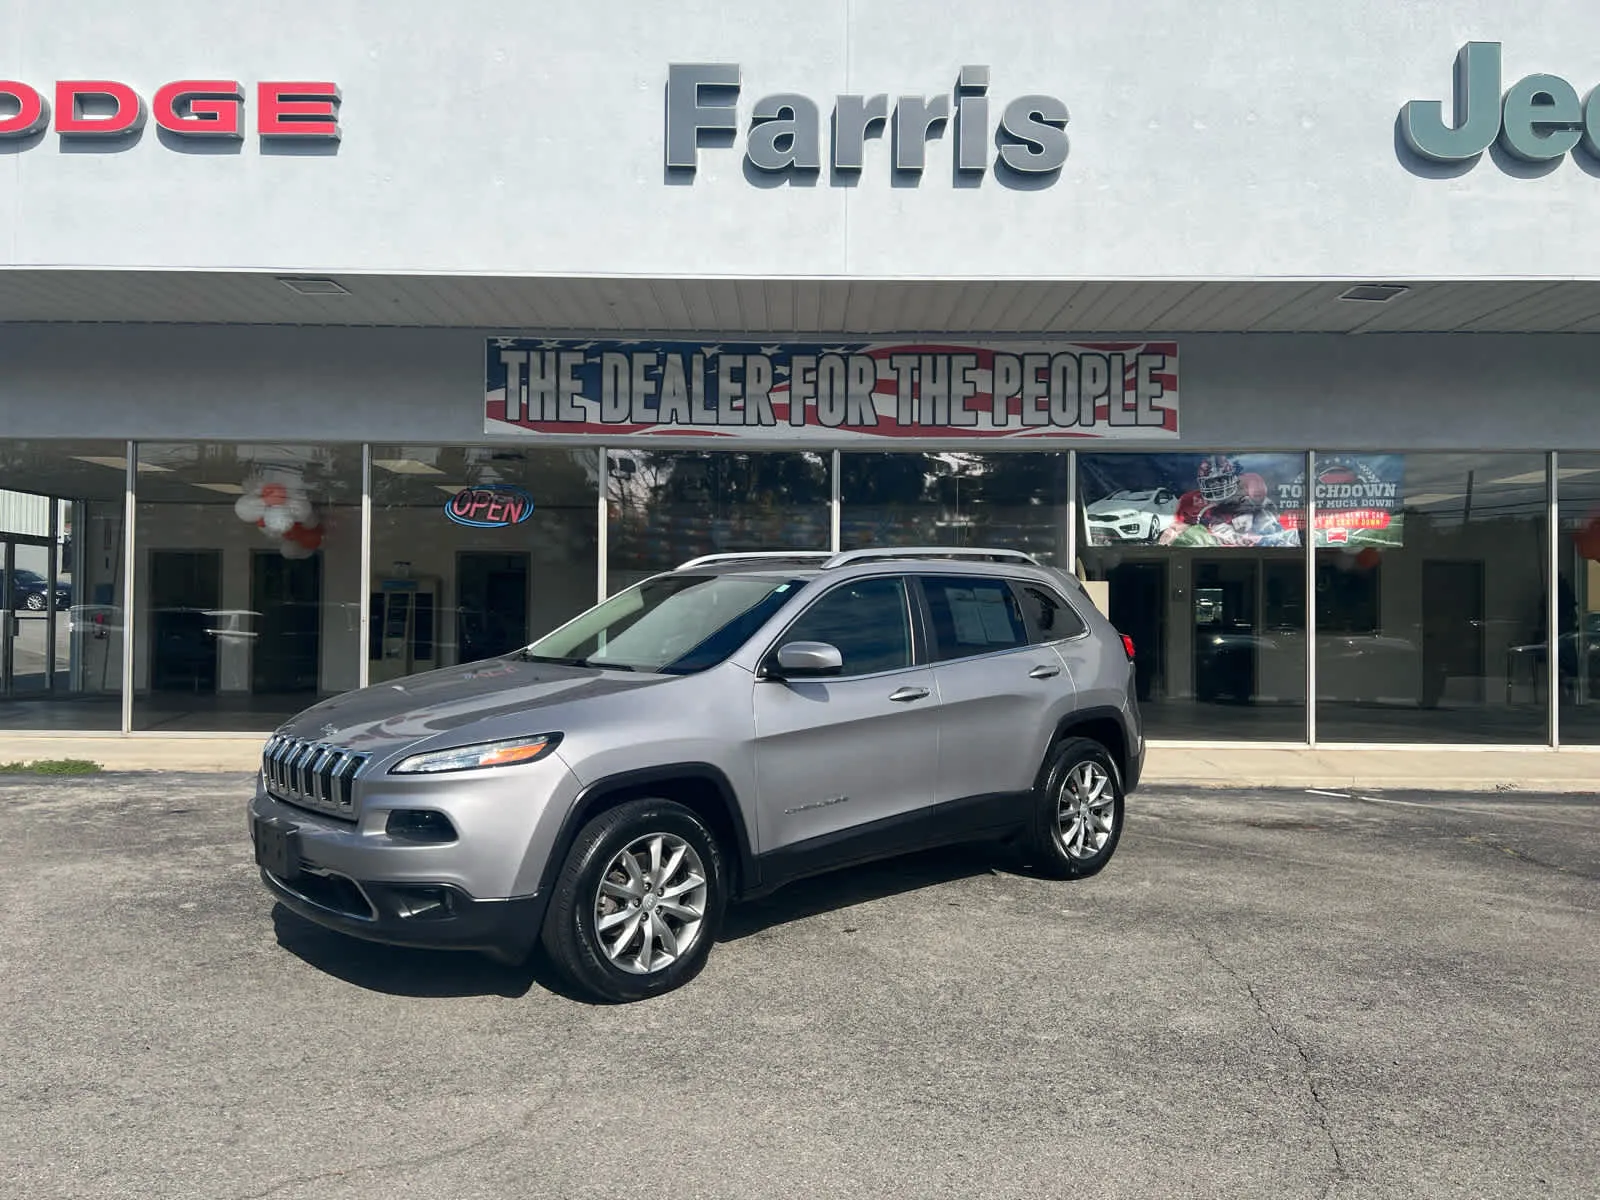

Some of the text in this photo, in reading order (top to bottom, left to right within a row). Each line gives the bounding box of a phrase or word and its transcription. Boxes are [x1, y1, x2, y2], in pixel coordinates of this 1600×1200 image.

[666, 62, 1072, 175] Farris
[1402, 41, 1600, 161] Je
[499, 350, 1166, 428] THE DEALER FOR THE PEOPLE
[453, 488, 525, 523] OPEN
[1278, 484, 1396, 498] TOCHDOWN
[1280, 500, 1300, 509] FOR
[1326, 499, 1358, 508] MUCH
